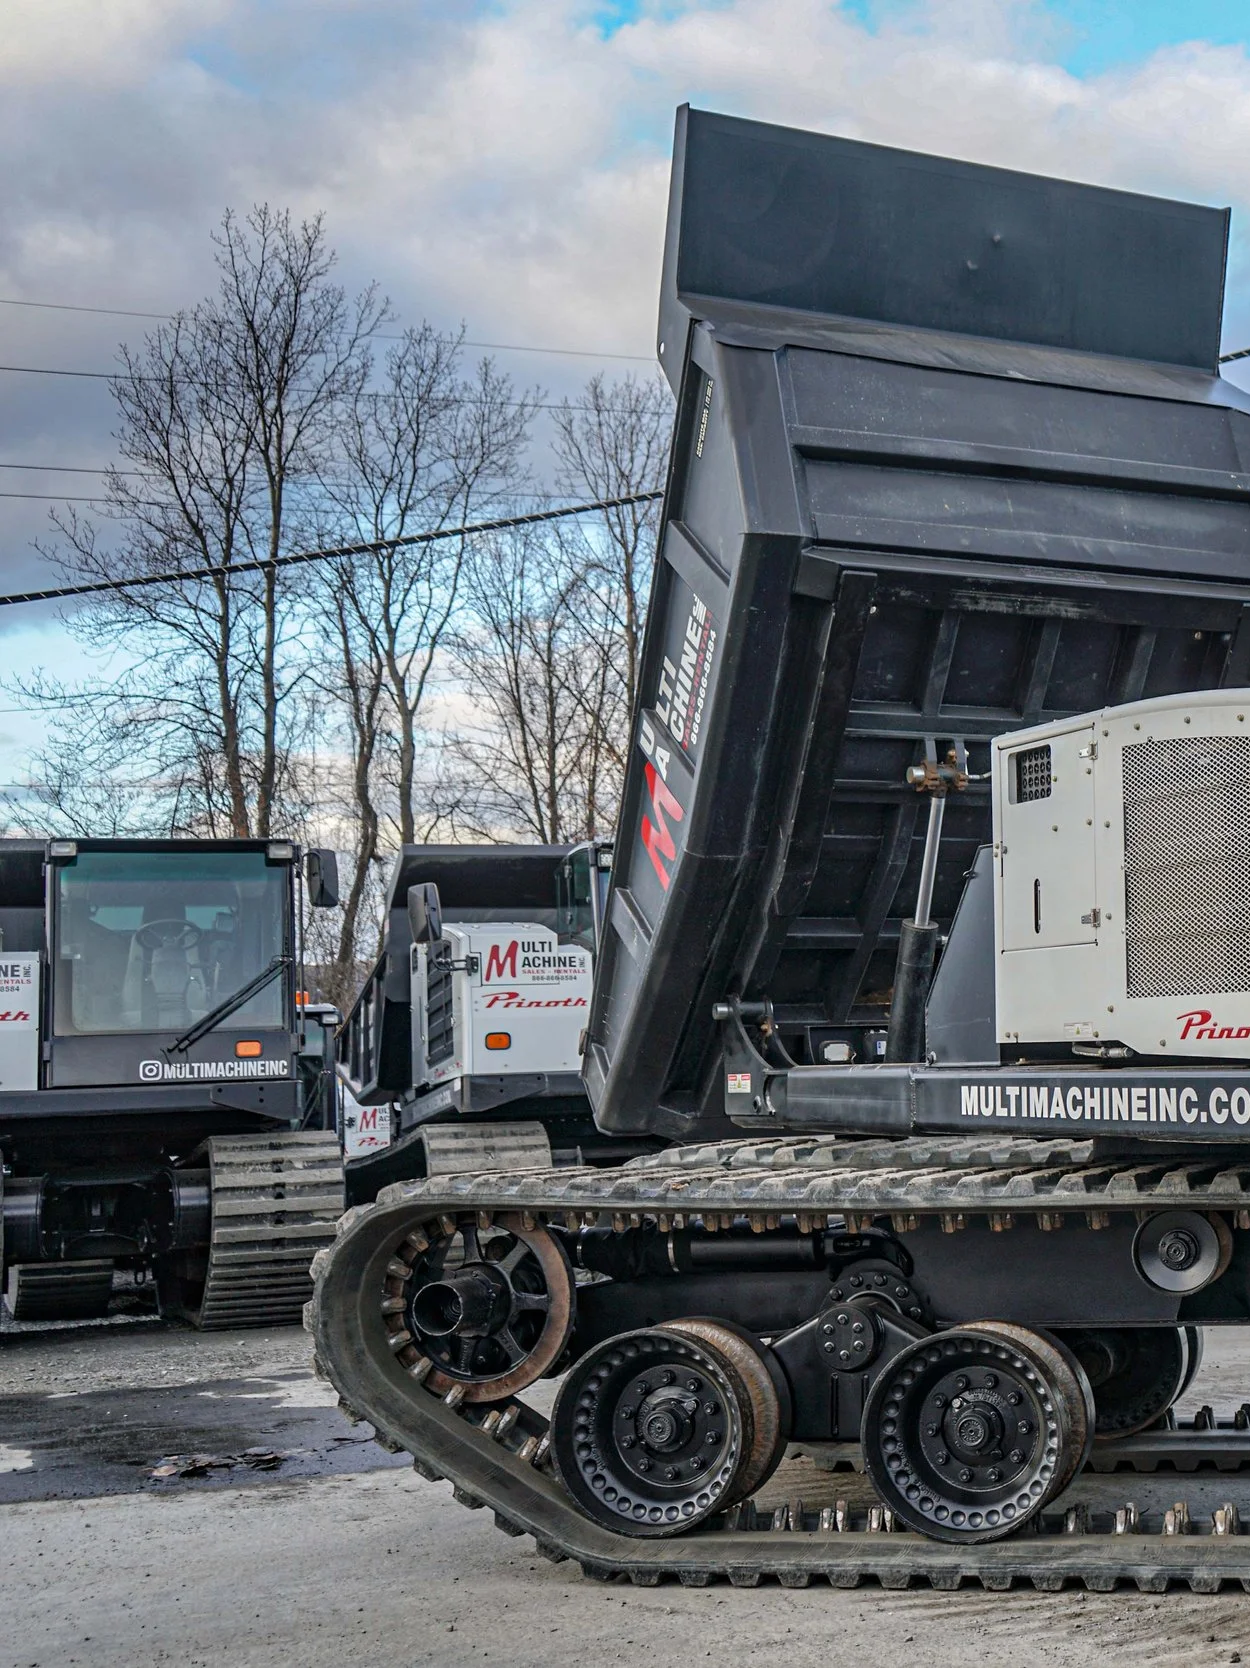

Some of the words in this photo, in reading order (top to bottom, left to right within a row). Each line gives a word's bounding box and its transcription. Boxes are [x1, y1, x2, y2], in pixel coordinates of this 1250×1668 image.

[690, 629, 717, 745] 866-866-8584
[481, 991, 588, 1009] Prinoth
[163, 1060, 288, 1080] MULTIMACHINEINC
